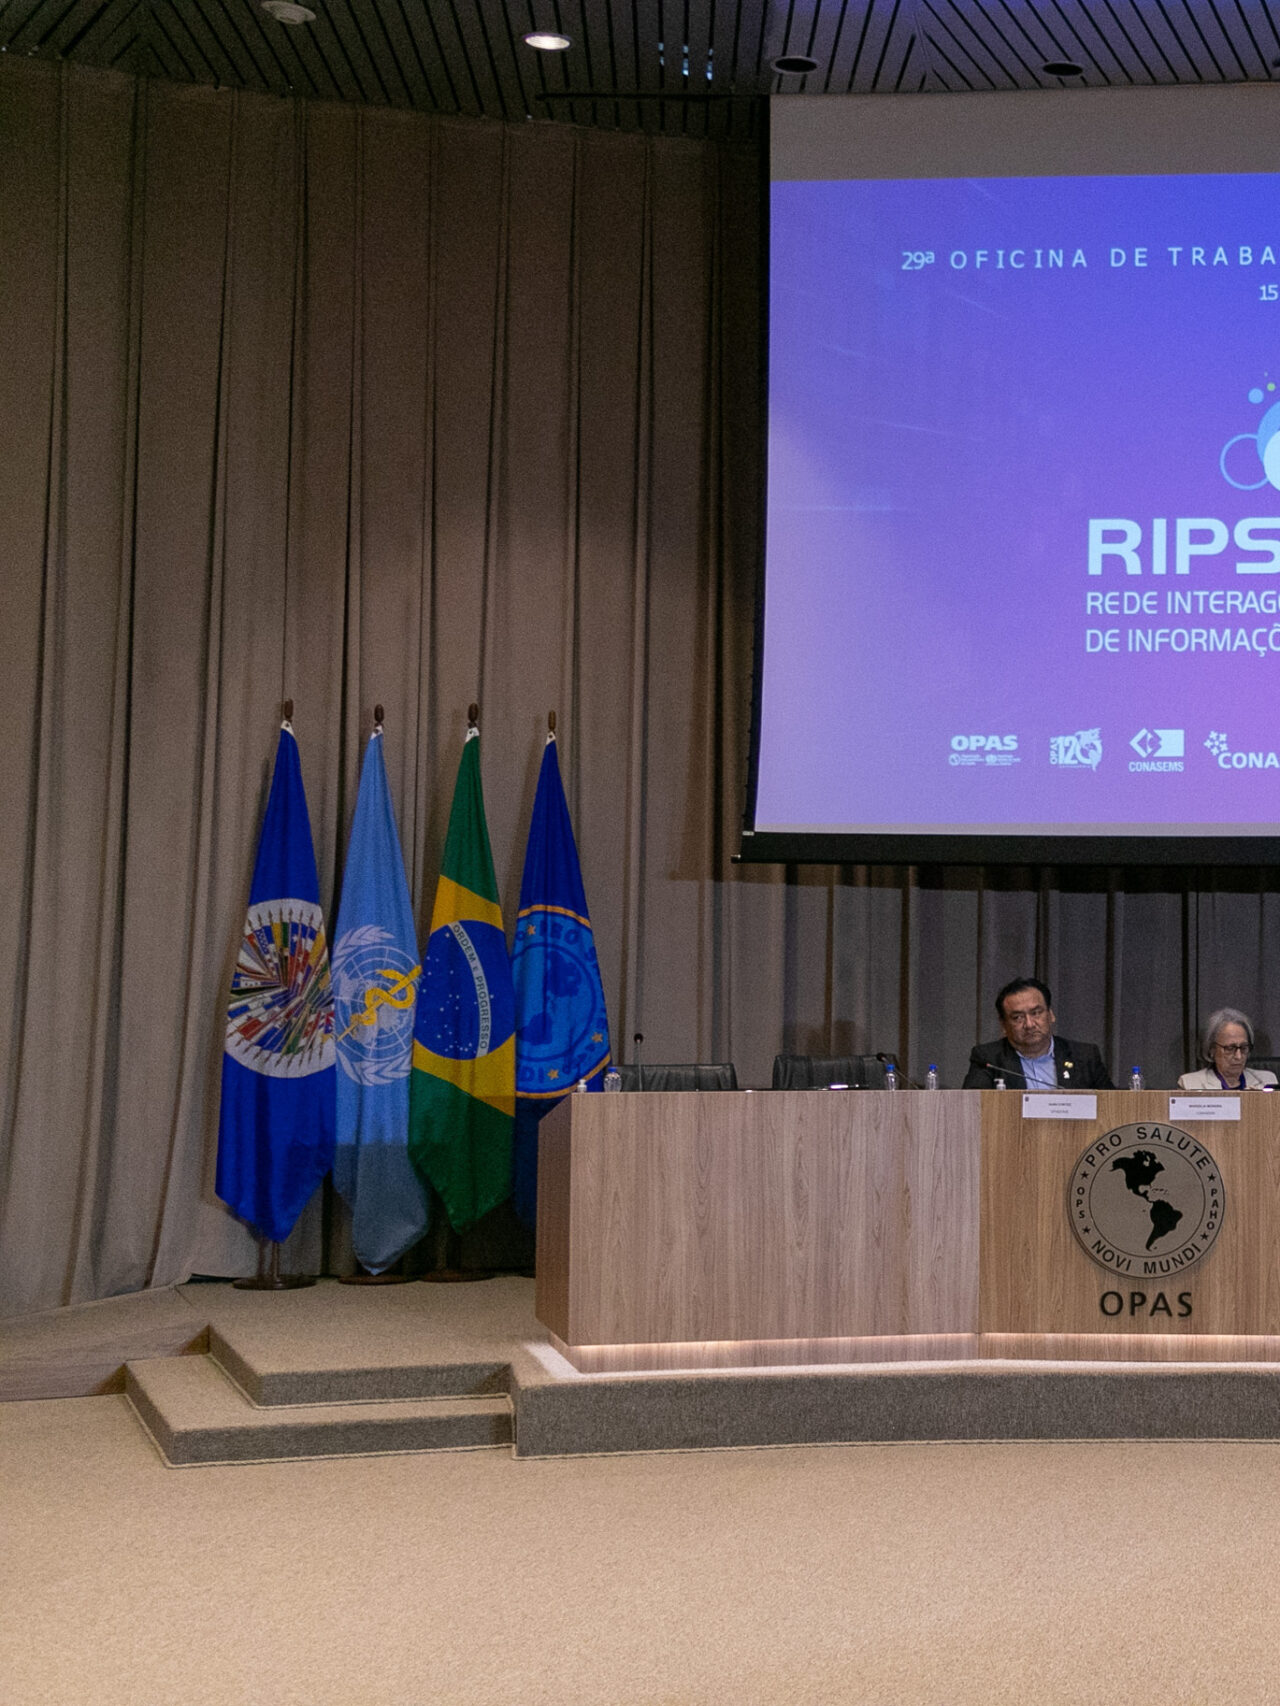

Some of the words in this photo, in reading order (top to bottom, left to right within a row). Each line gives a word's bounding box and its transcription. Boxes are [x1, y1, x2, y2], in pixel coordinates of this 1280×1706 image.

[950, 249, 1087, 269] OFICINA
[1110, 248, 1148, 267] DE
[1259, 284, 1278, 300] 15
[1086, 591, 1158, 614] REDE
[1086, 629, 1119, 652] DE
[951, 735, 1018, 751] OPAS
[1128, 761, 1184, 772] CONASEMS
[453, 924, 476, 962] ORDEM
[475, 975, 490, 1050] PROGRESSO
[1085, 1134, 1122, 1167] PRO
[1137, 1127, 1210, 1169] SALUTE
[1076, 1187, 1085, 1219] OPS
[1207, 1188, 1218, 1230] PAHO
[1092, 1240, 1132, 1271] NOVI
[1144, 1243, 1201, 1274] MUNDI
[1100, 1291, 1193, 1318] OPAS
